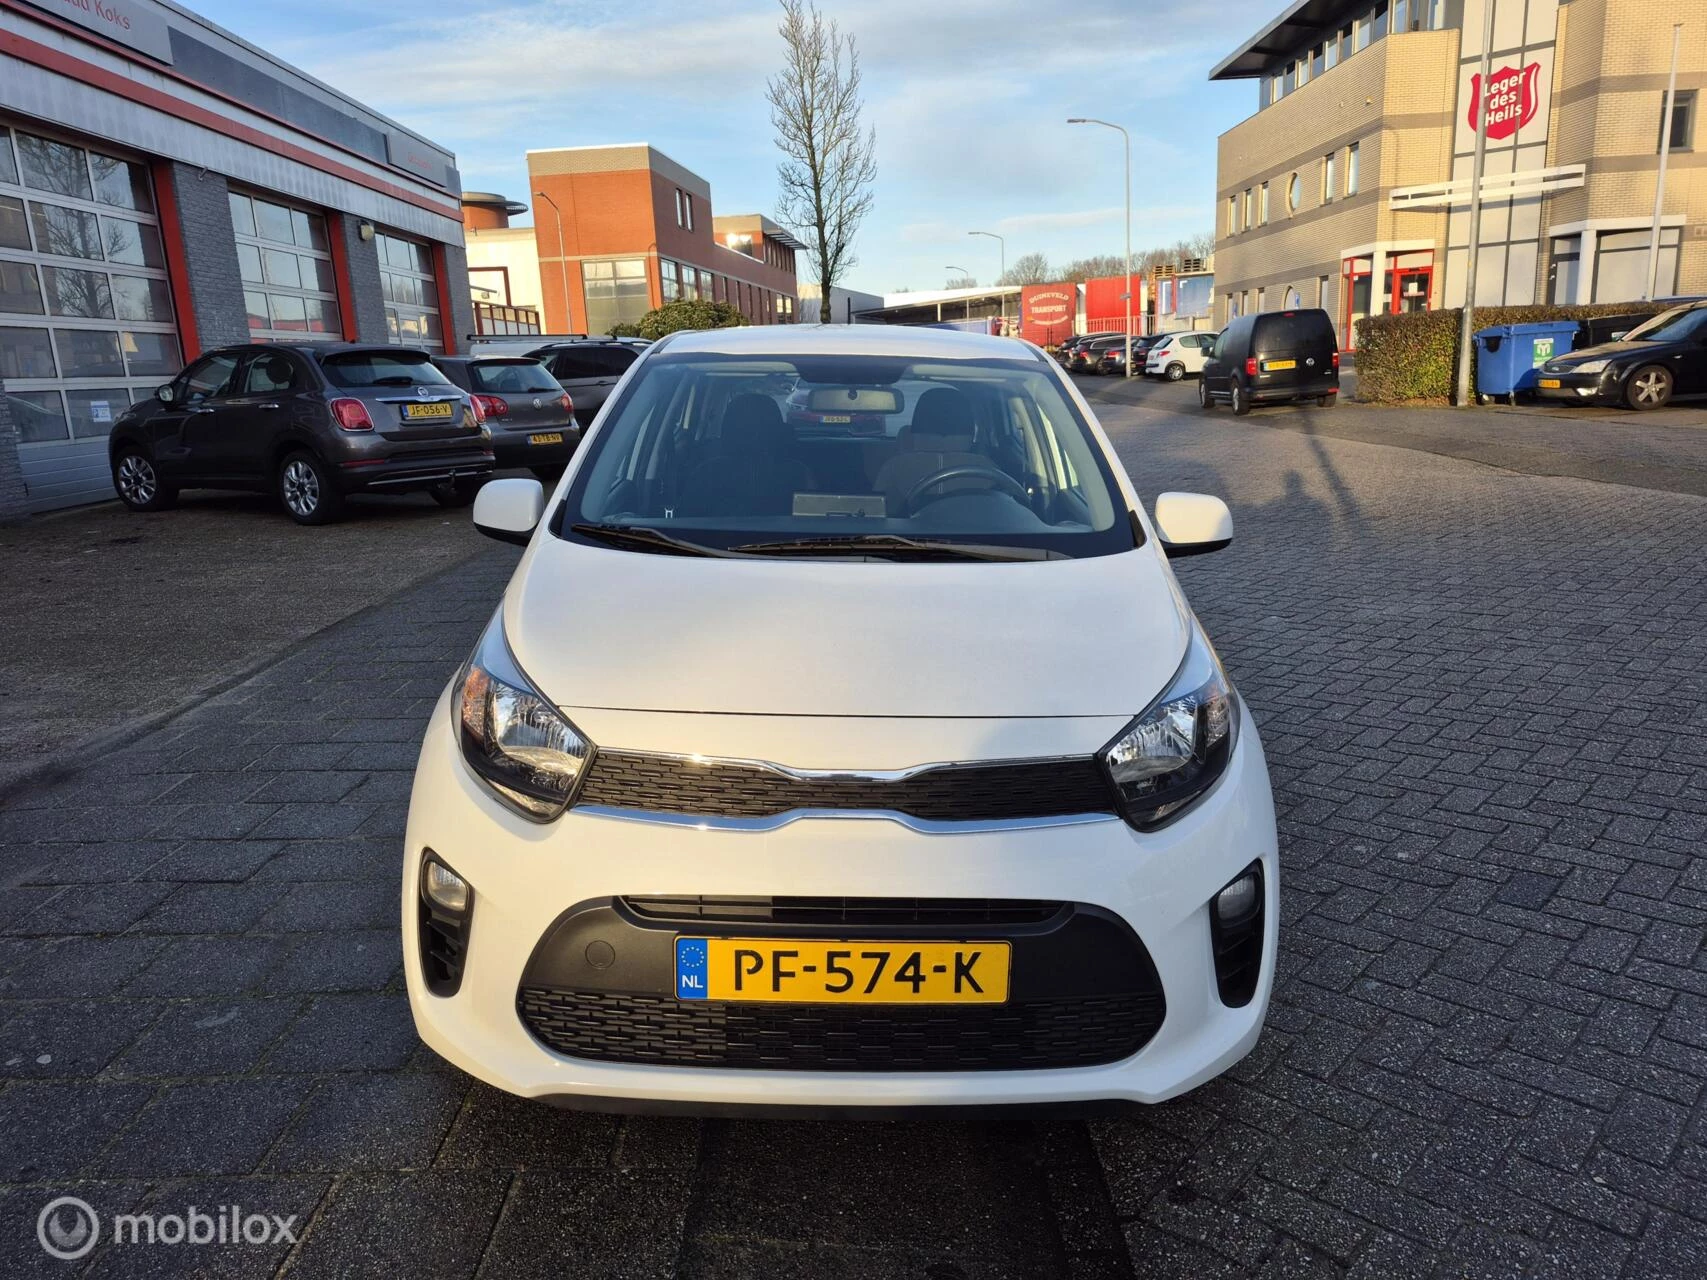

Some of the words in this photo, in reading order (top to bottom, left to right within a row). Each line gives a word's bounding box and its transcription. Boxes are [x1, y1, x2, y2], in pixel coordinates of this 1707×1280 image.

[95, 0, 131, 30] Koks
[1484, 71, 1527, 97] Leger
[1489, 91, 1517, 110] des
[1484, 104, 1523, 127] Heils
[1031, 305, 1067, 314] TRANSPORT
[410, 404, 449, 416] JF-056-V
[681, 975, 704, 989] NL
[734, 948, 984, 994] PF-574-K
